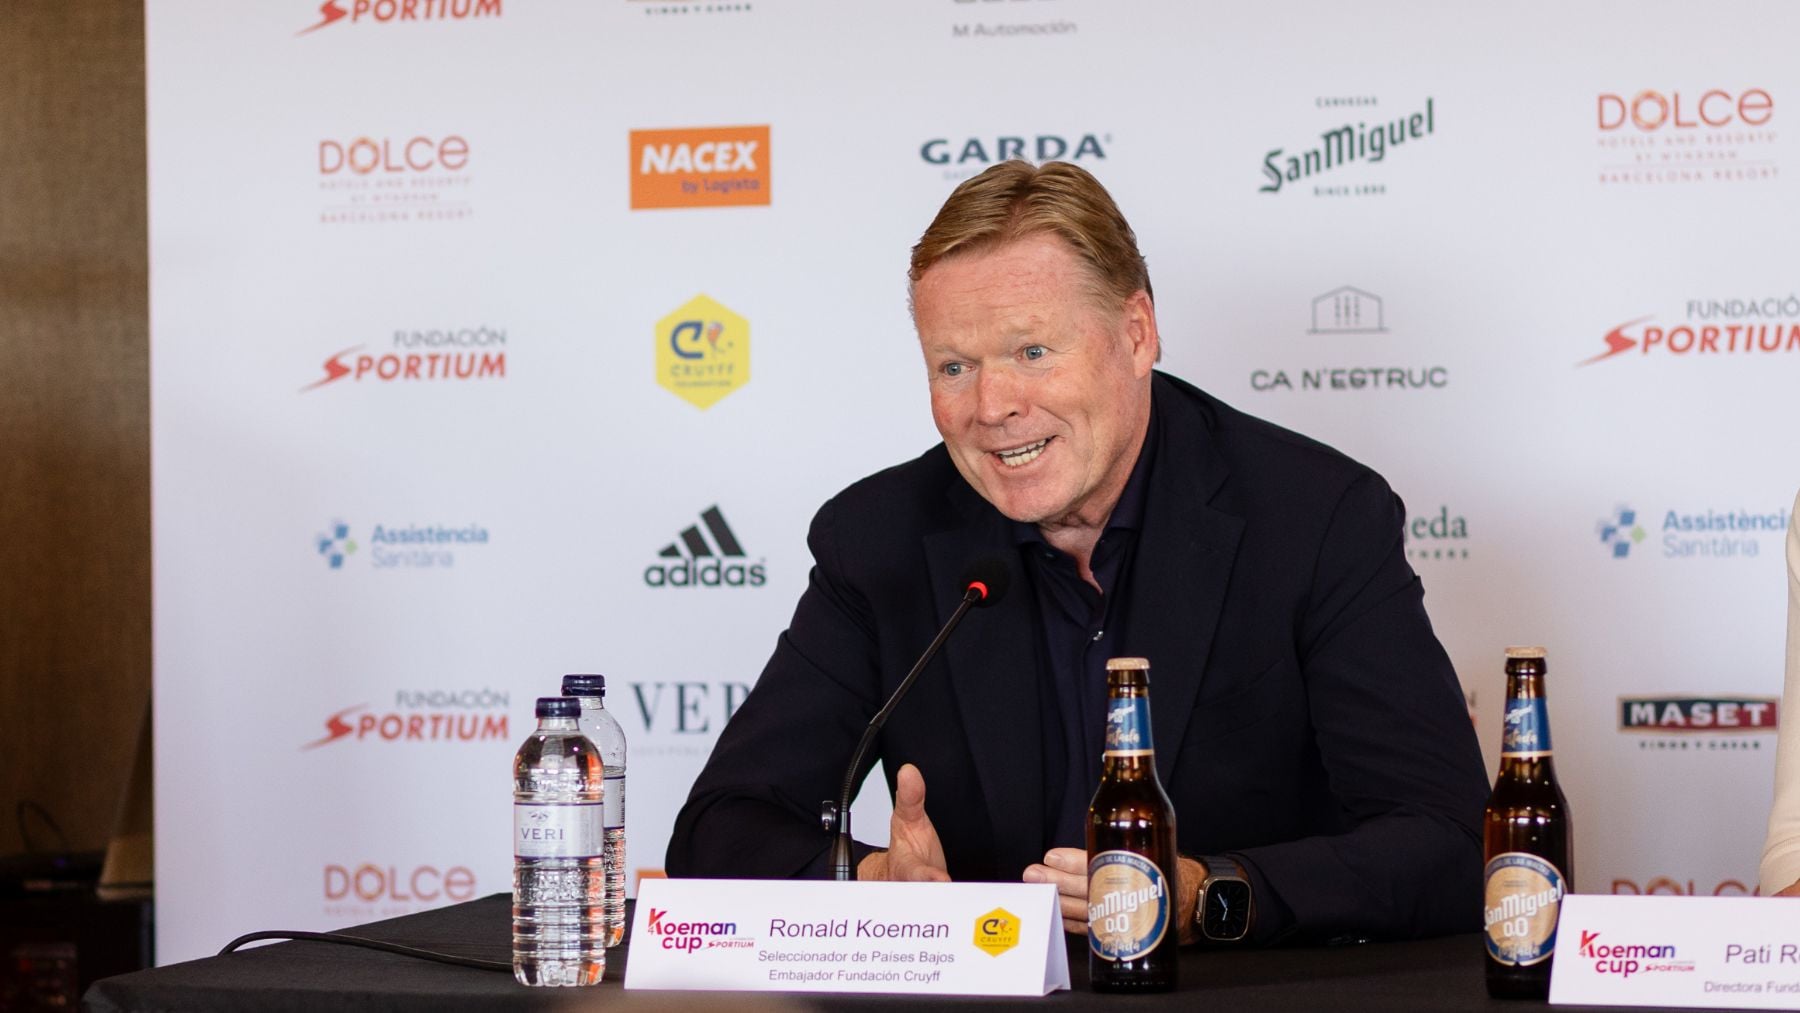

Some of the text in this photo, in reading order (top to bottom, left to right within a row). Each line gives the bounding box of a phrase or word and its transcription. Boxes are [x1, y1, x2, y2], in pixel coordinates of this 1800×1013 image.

[1597, 88, 1773, 132] DOLCE
[320, 135, 469, 174] DOLCE
[640, 141, 758, 174] NACEX
[920, 134, 1107, 165] GARDA
[393, 325, 506, 347] FUNDACIÓN
[1662, 508, 1791, 531] Assistènci
[644, 558, 767, 587] adidas
[1630, 702, 1769, 726] MASET
[521, 828, 564, 840] VERI
[648, 908, 737, 935] Koeman
[769, 919, 950, 938] Ronald Koeman
[662, 936, 703, 954] cup
[1579, 930, 1675, 959] Koeman
[1725, 944, 1771, 964] Pati
[758, 950, 955, 966] Seleccionador de Países Bajos
[1595, 959, 1639, 978] cup
[769, 969, 941, 985] Embajador Fundación Cruyff
[1704, 981, 1762, 993] Directora
